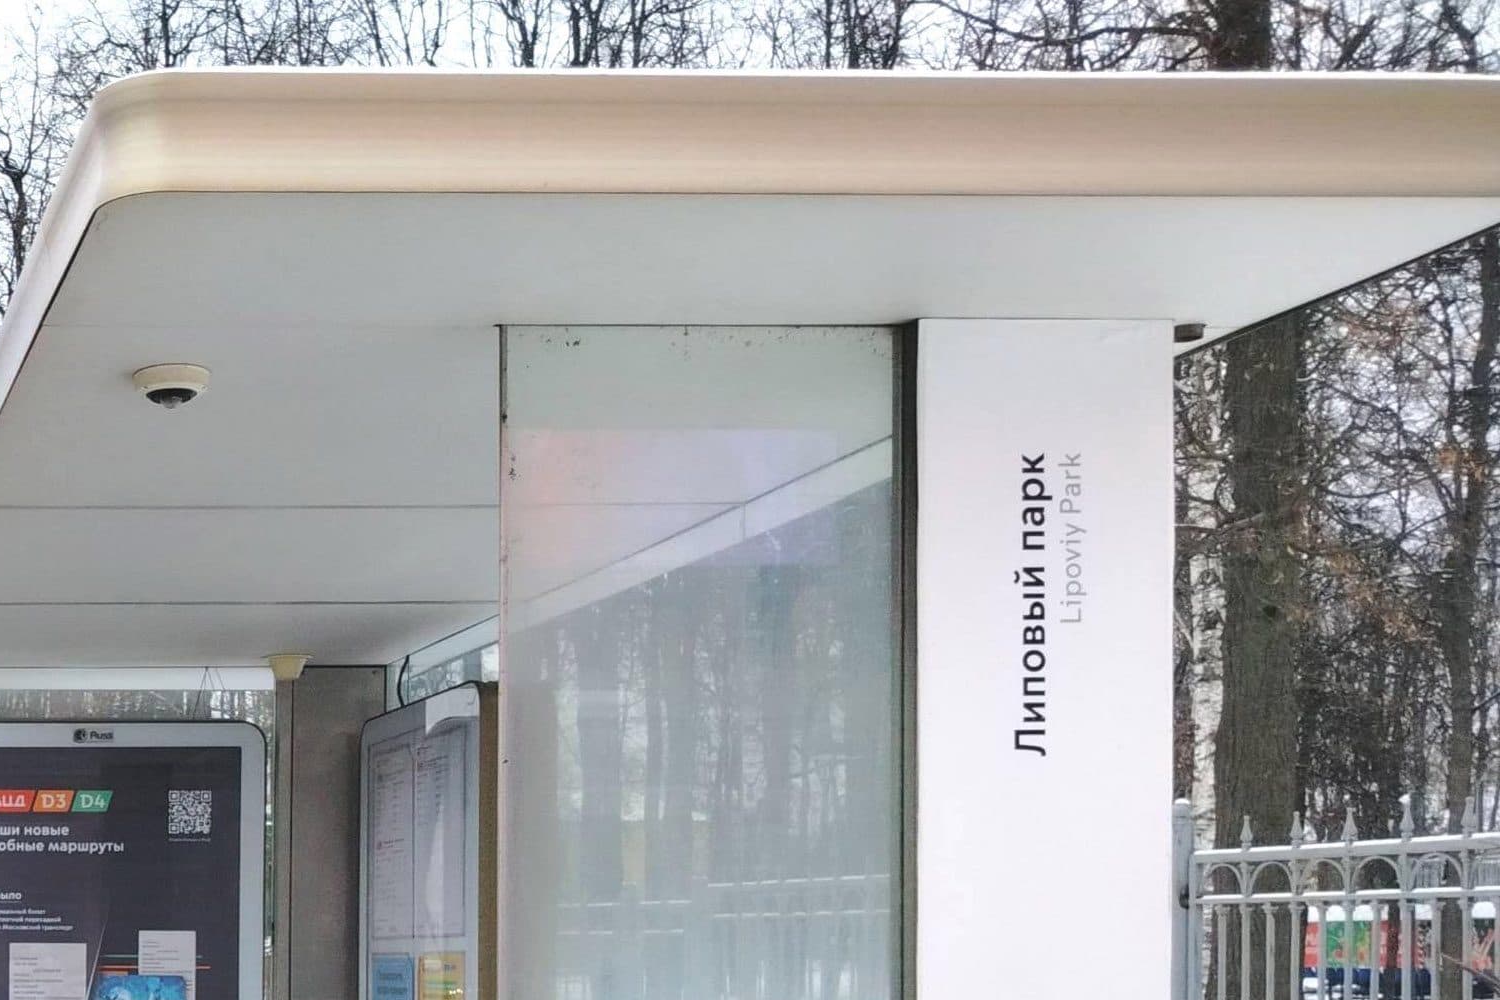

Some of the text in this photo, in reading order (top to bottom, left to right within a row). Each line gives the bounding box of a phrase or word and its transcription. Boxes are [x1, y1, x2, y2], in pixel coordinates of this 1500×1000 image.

[1058, 452, 1087, 624] Lipoviy Park
[1013, 453, 1053, 757] Липовый парк
[40, 794, 66, 809] D3
[79, 794, 106, 809] D4
[24, 825, 70, 836] новые
[48, 841, 125, 855] маршруты
